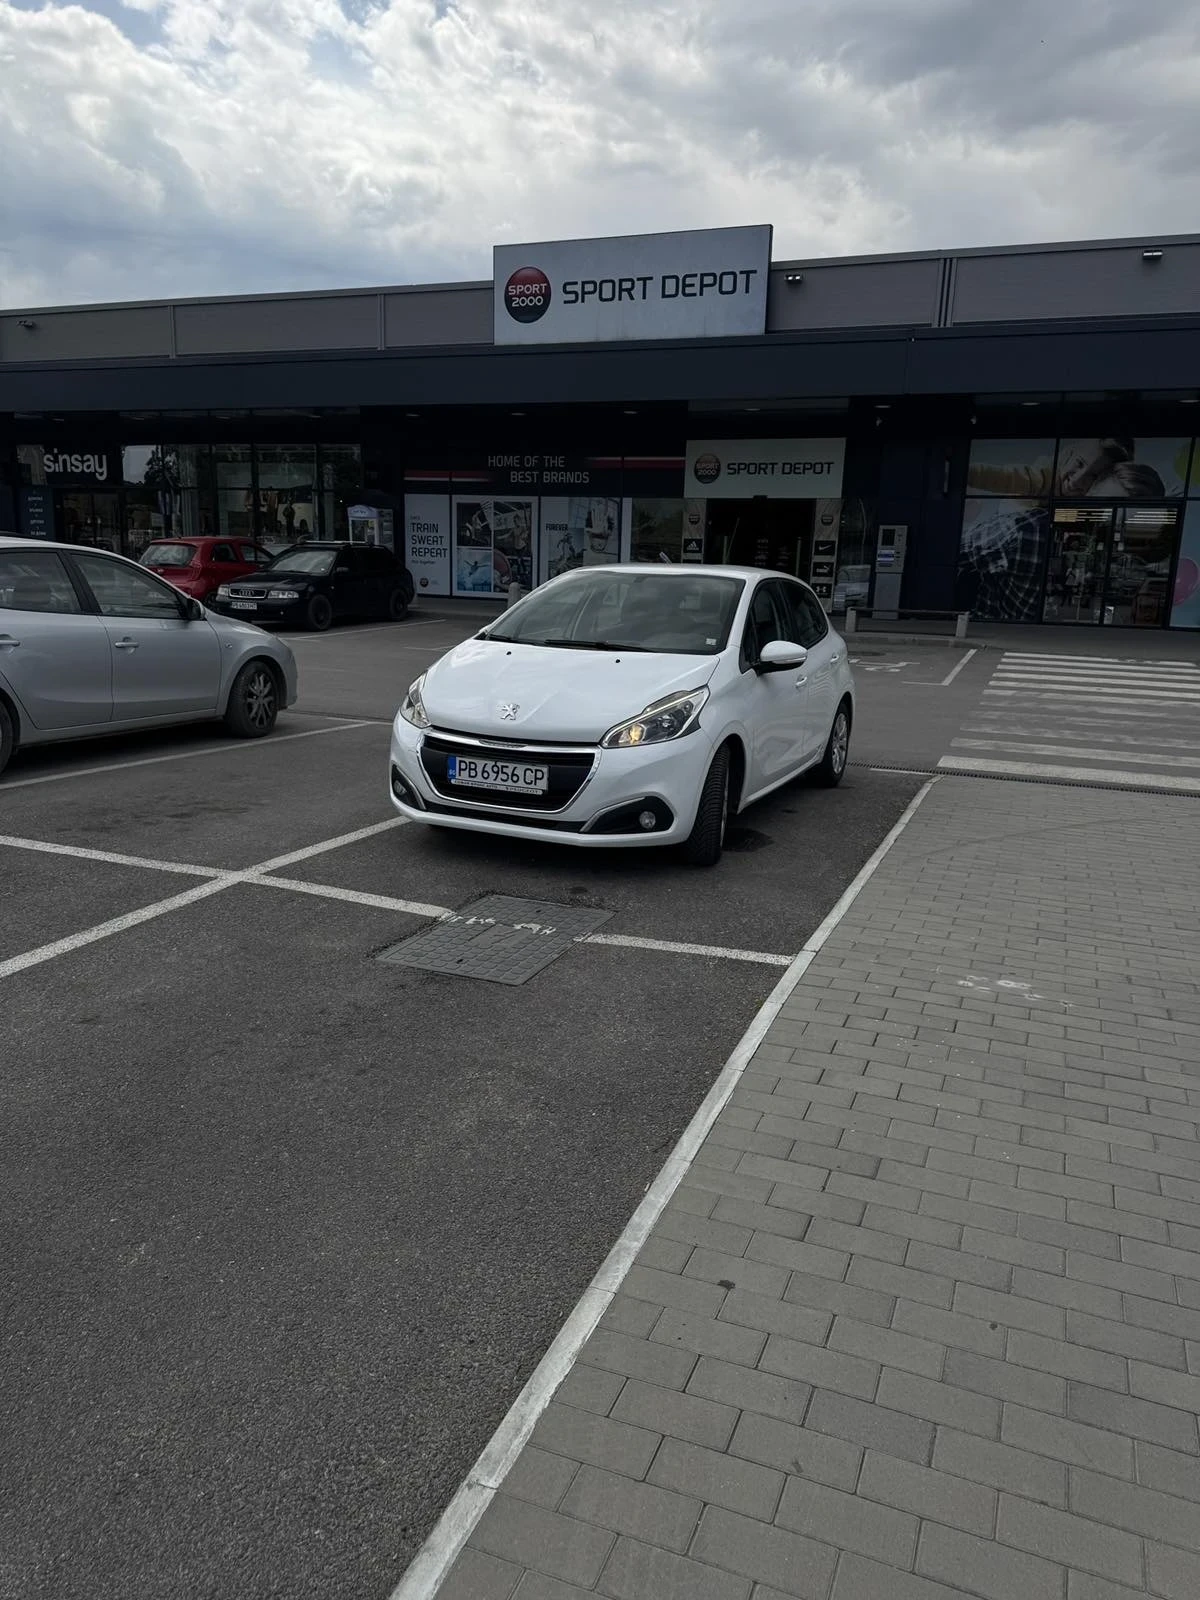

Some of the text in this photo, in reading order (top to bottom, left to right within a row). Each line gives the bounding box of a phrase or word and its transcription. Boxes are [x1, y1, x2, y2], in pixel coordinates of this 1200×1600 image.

[508, 283, 547, 296] SPORT
[562, 269, 757, 305] SPORT DEPOT
[511, 296, 544, 307] 2000
[43, 448, 107, 481] sinsay
[488, 455, 566, 468] HOME OF THE
[727, 462, 834, 475] SPORT DEPOT
[510, 471, 590, 484] BEST BRANDS
[411, 522, 439, 533] TRAIN
[411, 535, 444, 545] SWEAT
[411, 547, 448, 558] REPEAT
[458, 759, 545, 786] PB 6956 CP
